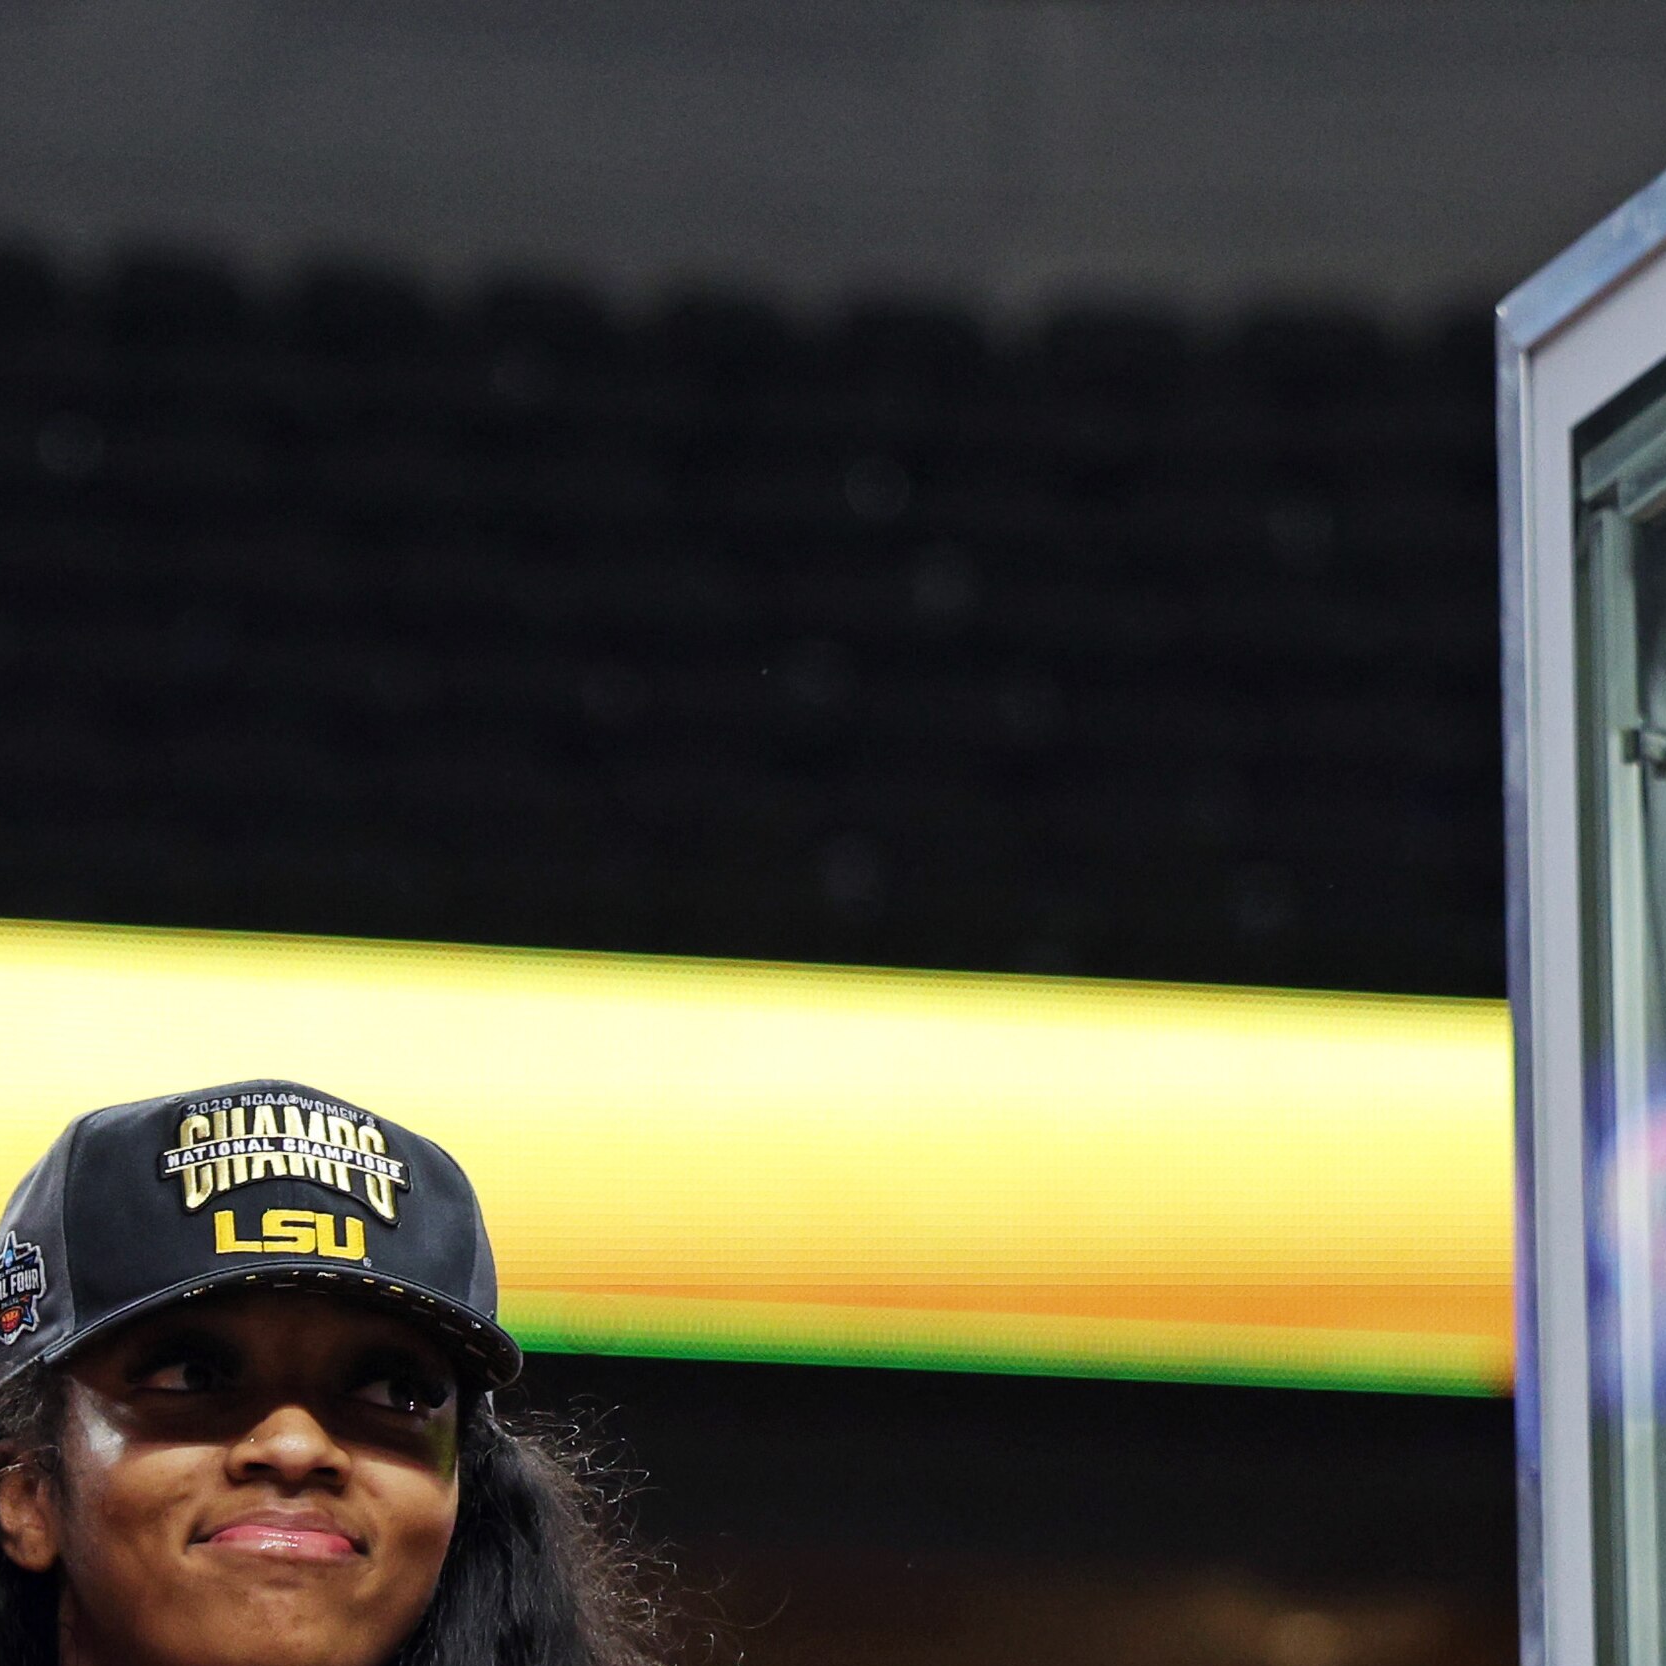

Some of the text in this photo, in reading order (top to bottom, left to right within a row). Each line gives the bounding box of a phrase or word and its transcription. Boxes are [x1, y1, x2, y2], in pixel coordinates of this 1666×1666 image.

[299, 1097, 375, 1127] WOMEN'S
[167, 1137, 401, 1178] NATIONAL CHAMPIONS
[180, 1105, 396, 1220] CHAMPS
[214, 1209, 366, 1260] LSU
[10, 1268, 40, 1296] FOUR
